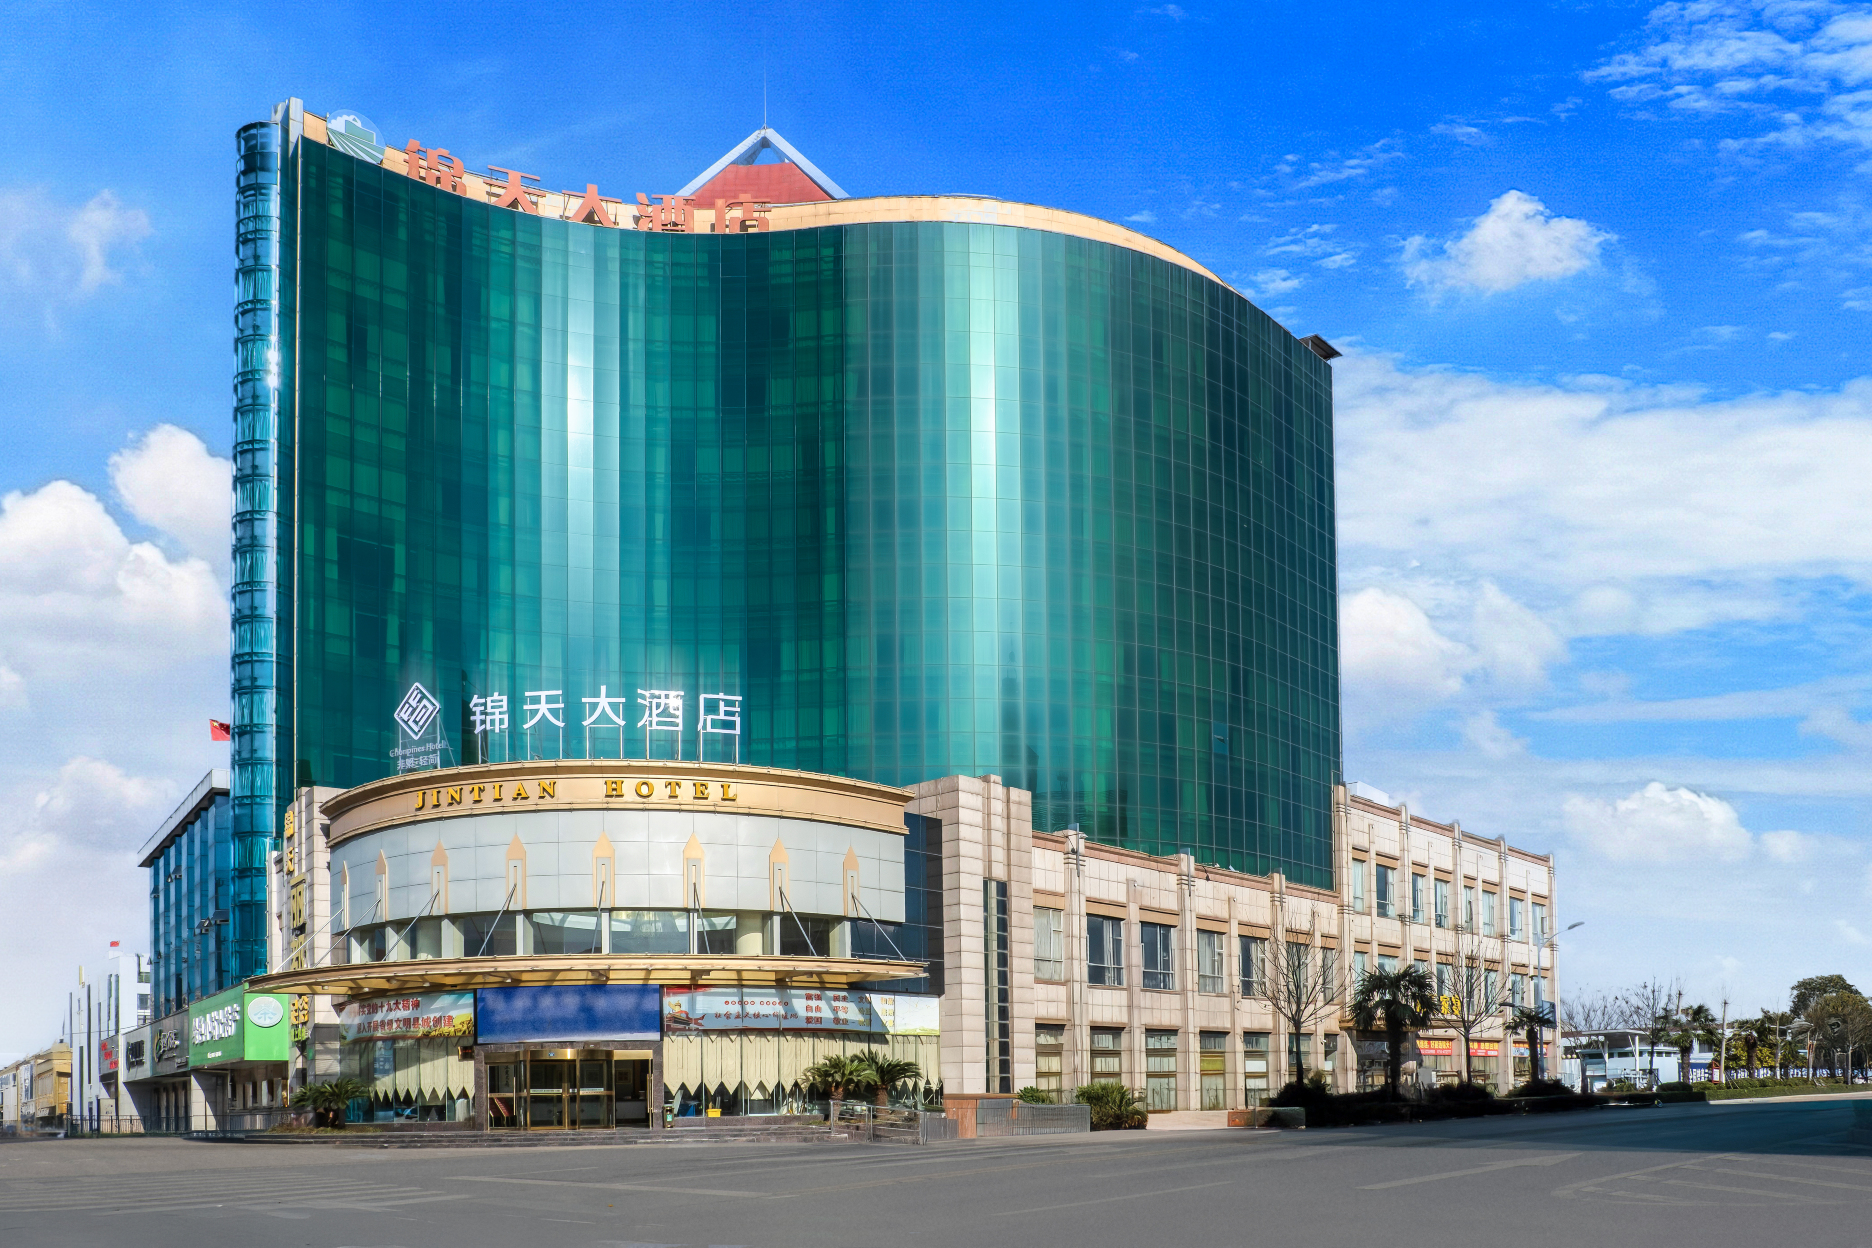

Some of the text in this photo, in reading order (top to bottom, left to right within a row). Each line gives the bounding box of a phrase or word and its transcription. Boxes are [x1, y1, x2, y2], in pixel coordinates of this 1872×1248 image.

[403, 138, 773, 234] 锦天大酒店
[469, 684, 743, 736] 锦天大酒店
[415, 779, 739, 810] JINTIAN HOTEL
